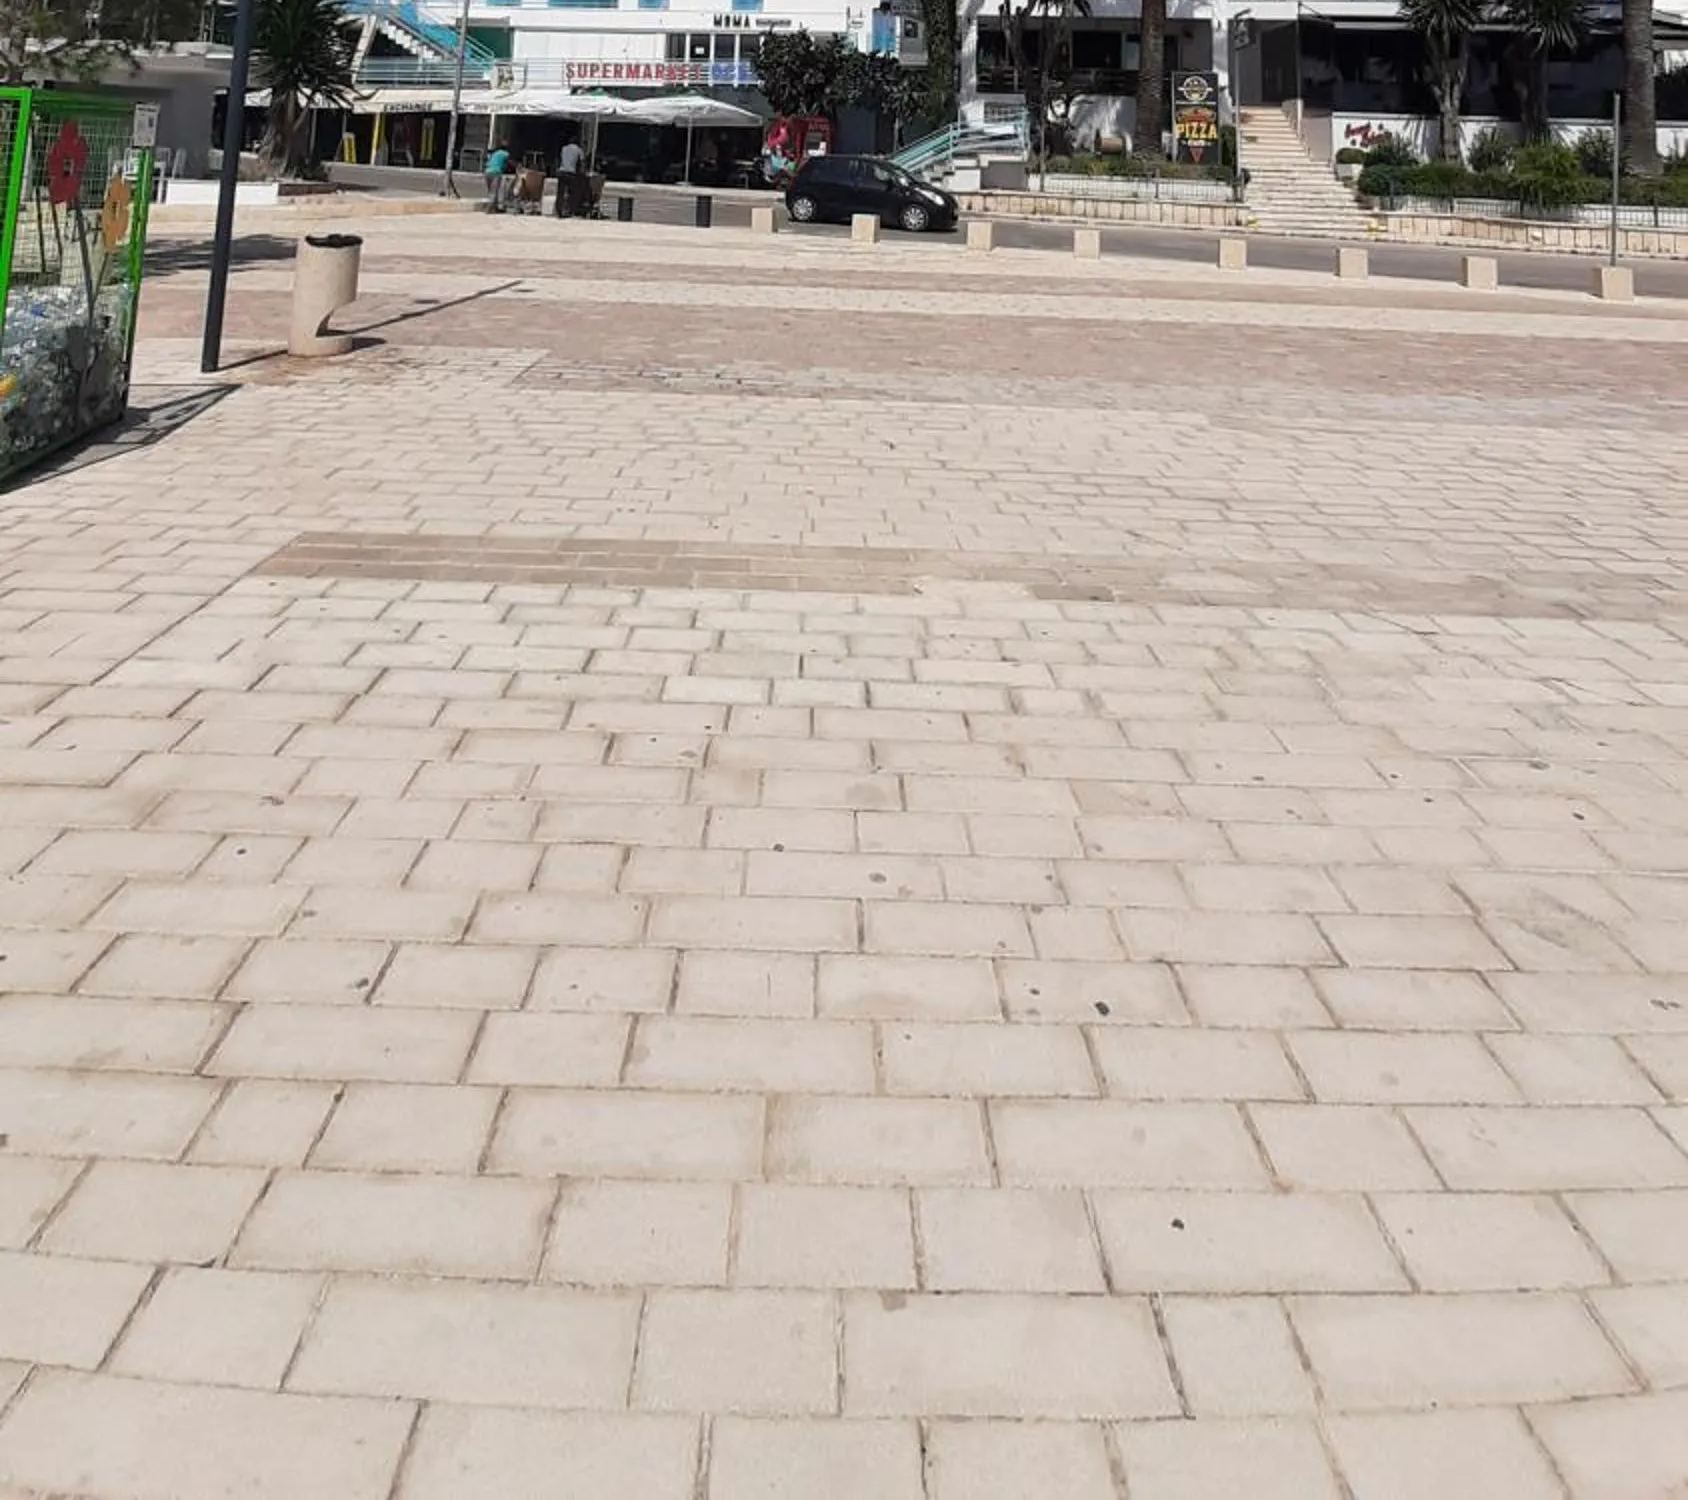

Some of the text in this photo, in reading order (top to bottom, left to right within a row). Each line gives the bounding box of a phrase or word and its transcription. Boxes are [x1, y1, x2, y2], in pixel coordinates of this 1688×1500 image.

[566, 62, 701, 80] SUPERMARKET
[384, 103, 434, 112] EXCHANGE
[1175, 122, 1217, 139] PIZZA
